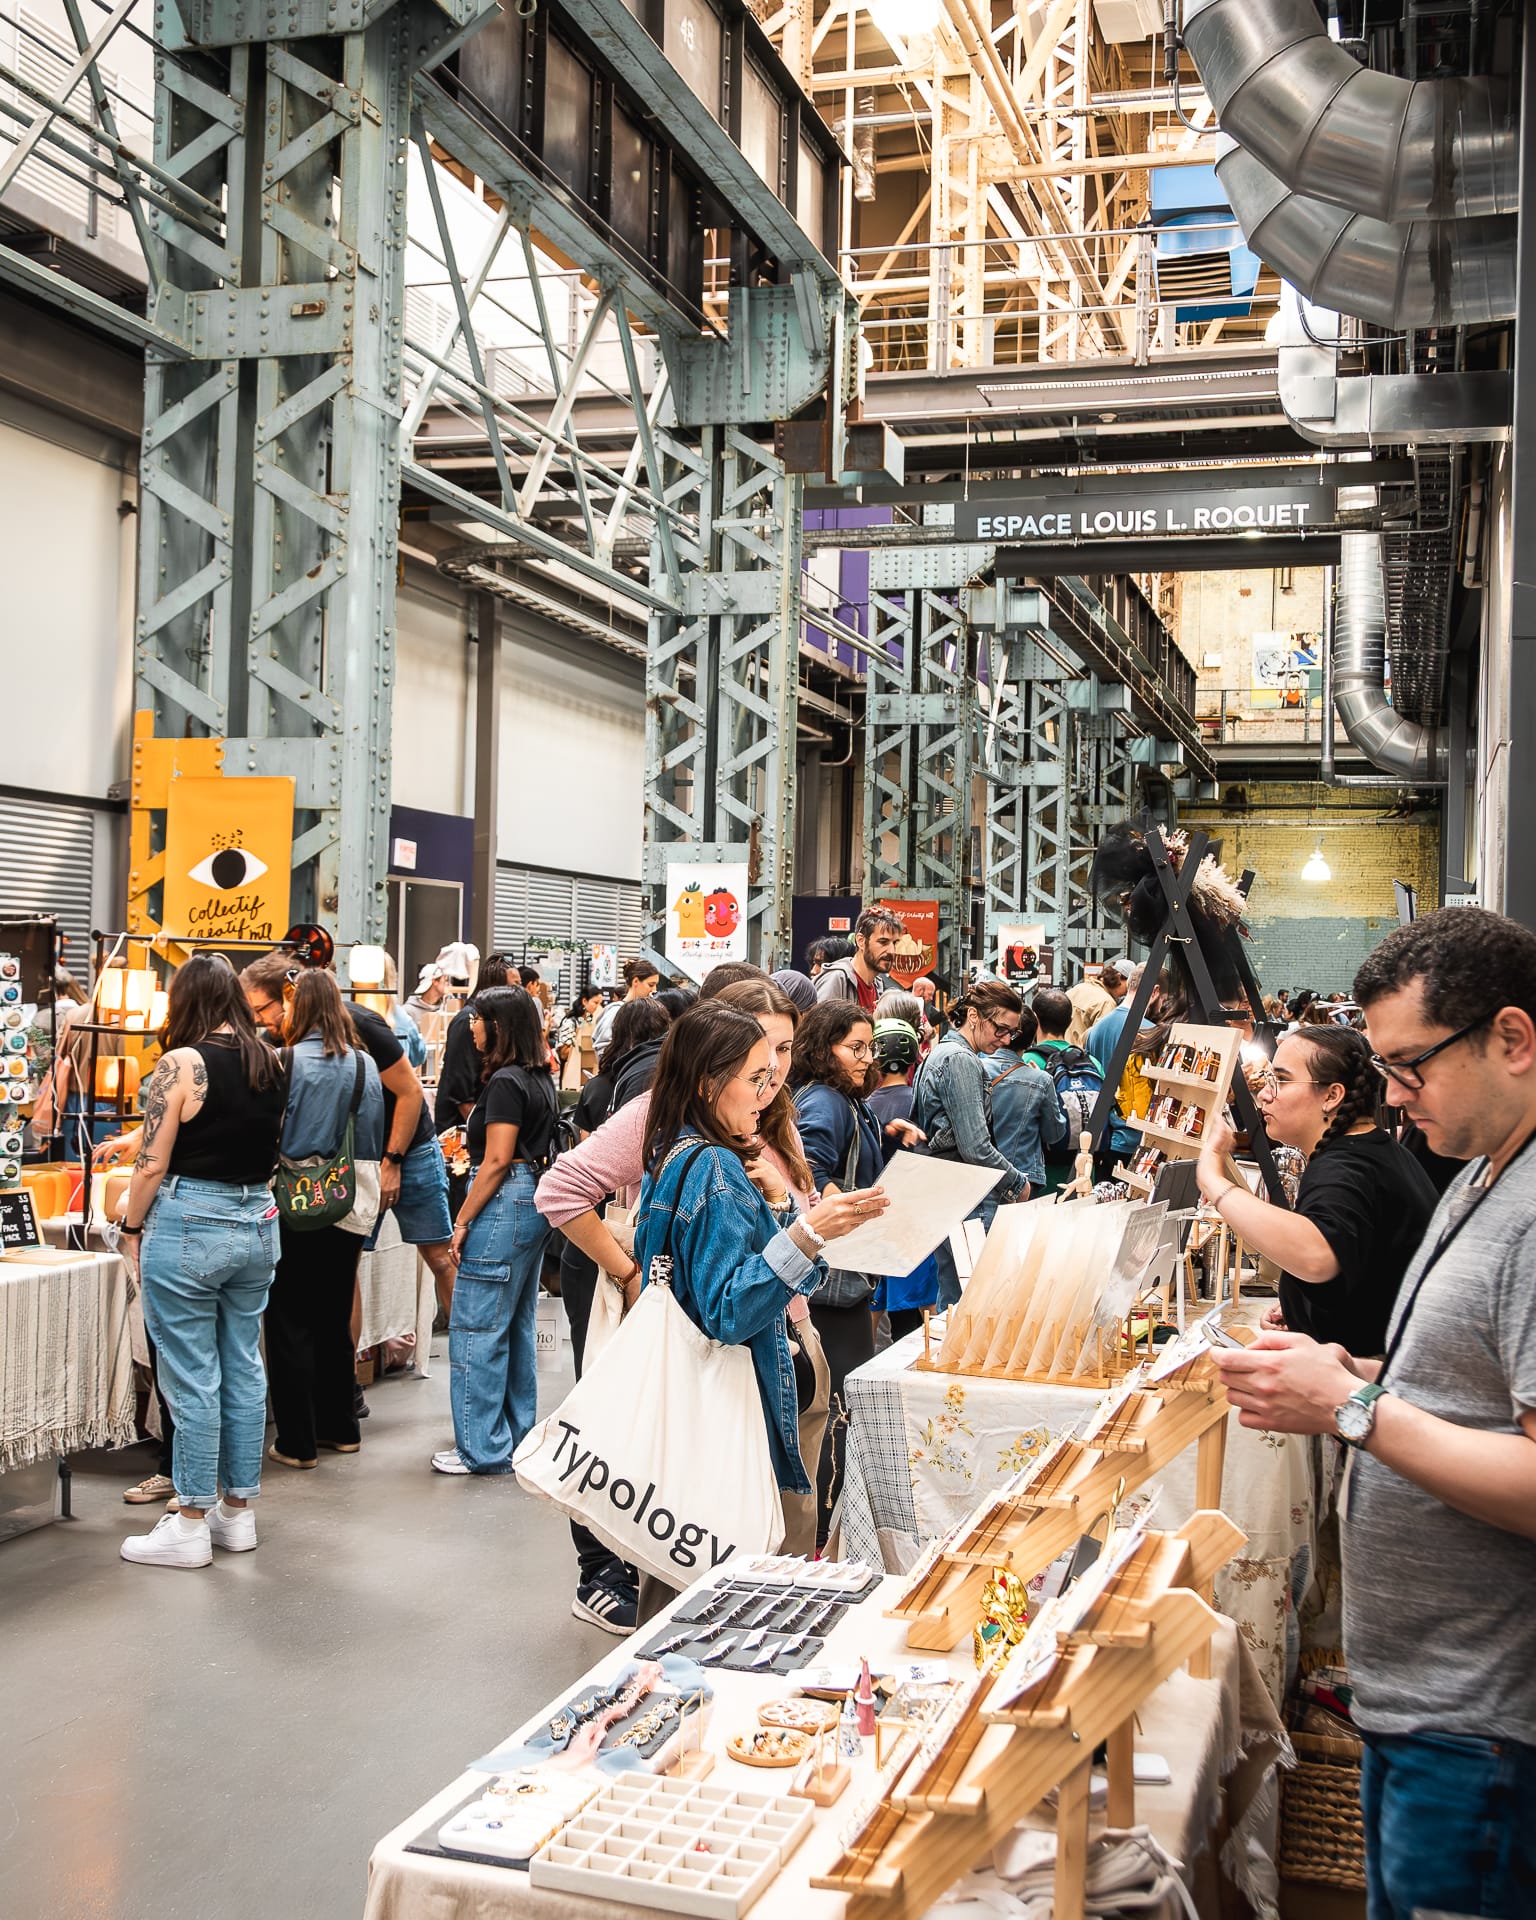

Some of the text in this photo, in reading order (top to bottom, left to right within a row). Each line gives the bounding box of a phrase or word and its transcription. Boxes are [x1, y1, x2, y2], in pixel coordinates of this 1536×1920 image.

[977, 503, 1310, 538] ESPACE LOUIS L. ROQUET
[553, 1420, 736, 1568] Typology
